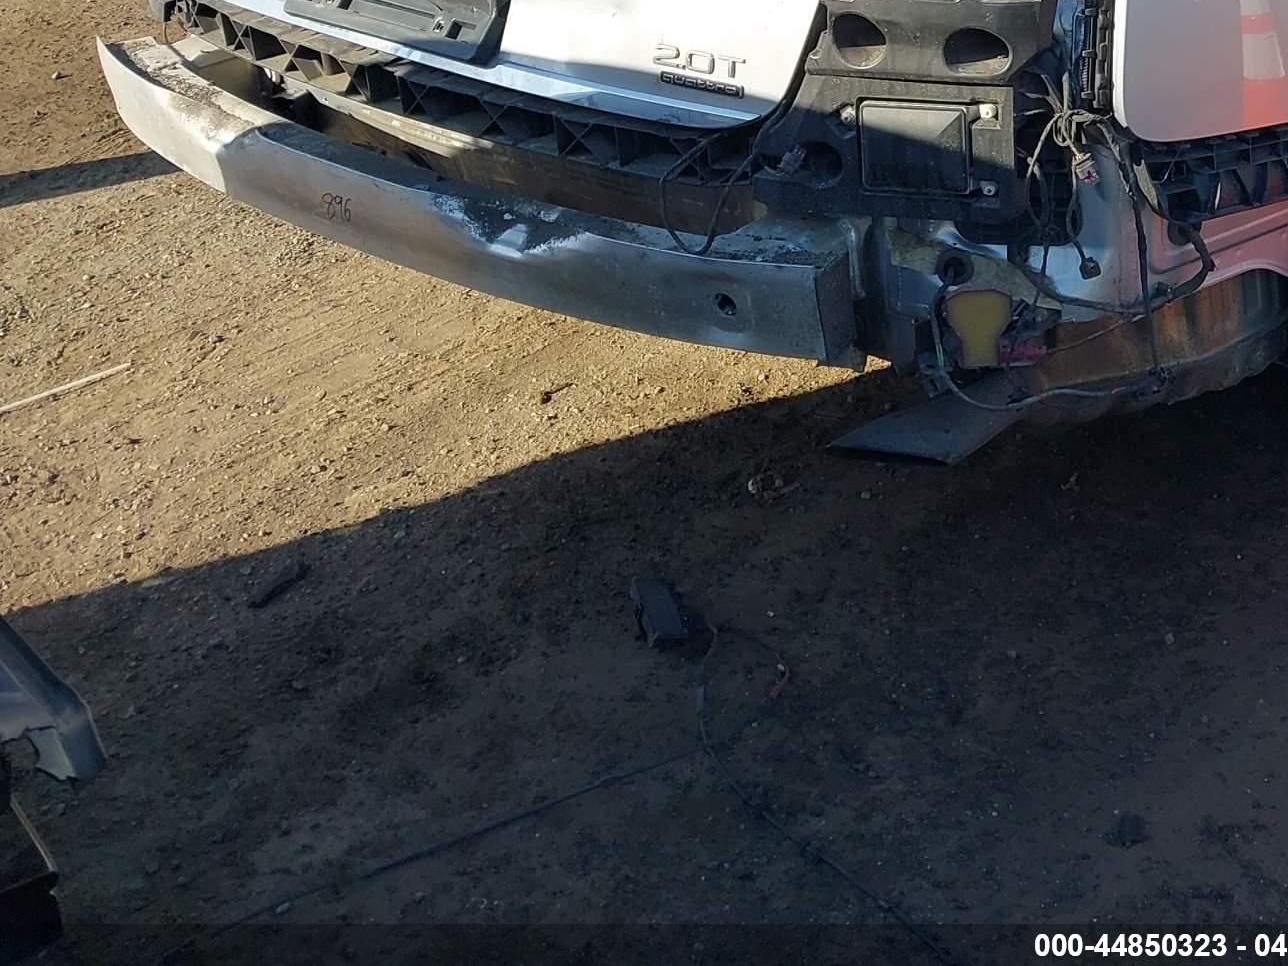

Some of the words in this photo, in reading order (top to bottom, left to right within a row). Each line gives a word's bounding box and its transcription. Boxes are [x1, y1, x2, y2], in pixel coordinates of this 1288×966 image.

[653, 43, 747, 79] 2.0T
[661, 72, 739, 95] quattro
[321, 192, 352, 223] 896
